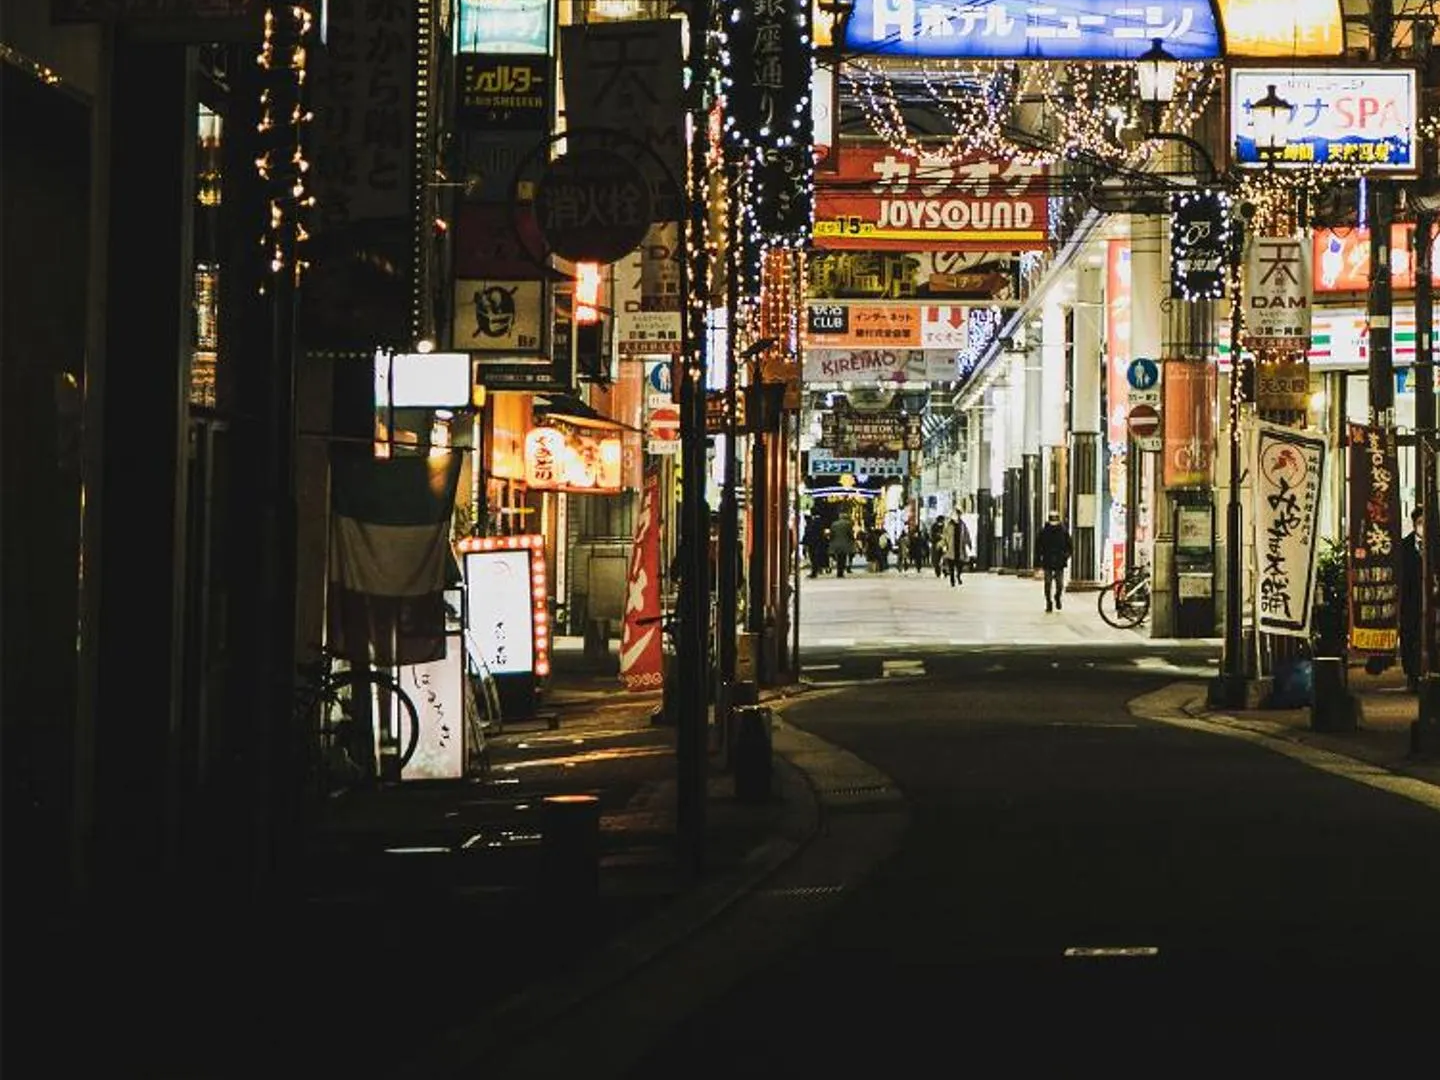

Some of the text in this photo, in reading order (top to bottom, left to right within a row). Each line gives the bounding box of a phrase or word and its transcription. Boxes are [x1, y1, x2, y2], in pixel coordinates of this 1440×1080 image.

[870, 155, 1043, 198] カラオケ
[545, 182, 642, 230] 消火栓
[877, 199, 1034, 230] JOYSOUND
[1250, 296, 1307, 310] DAM
[813, 317, 843, 328] CLUB
[821, 350, 897, 376] KIREIMO
